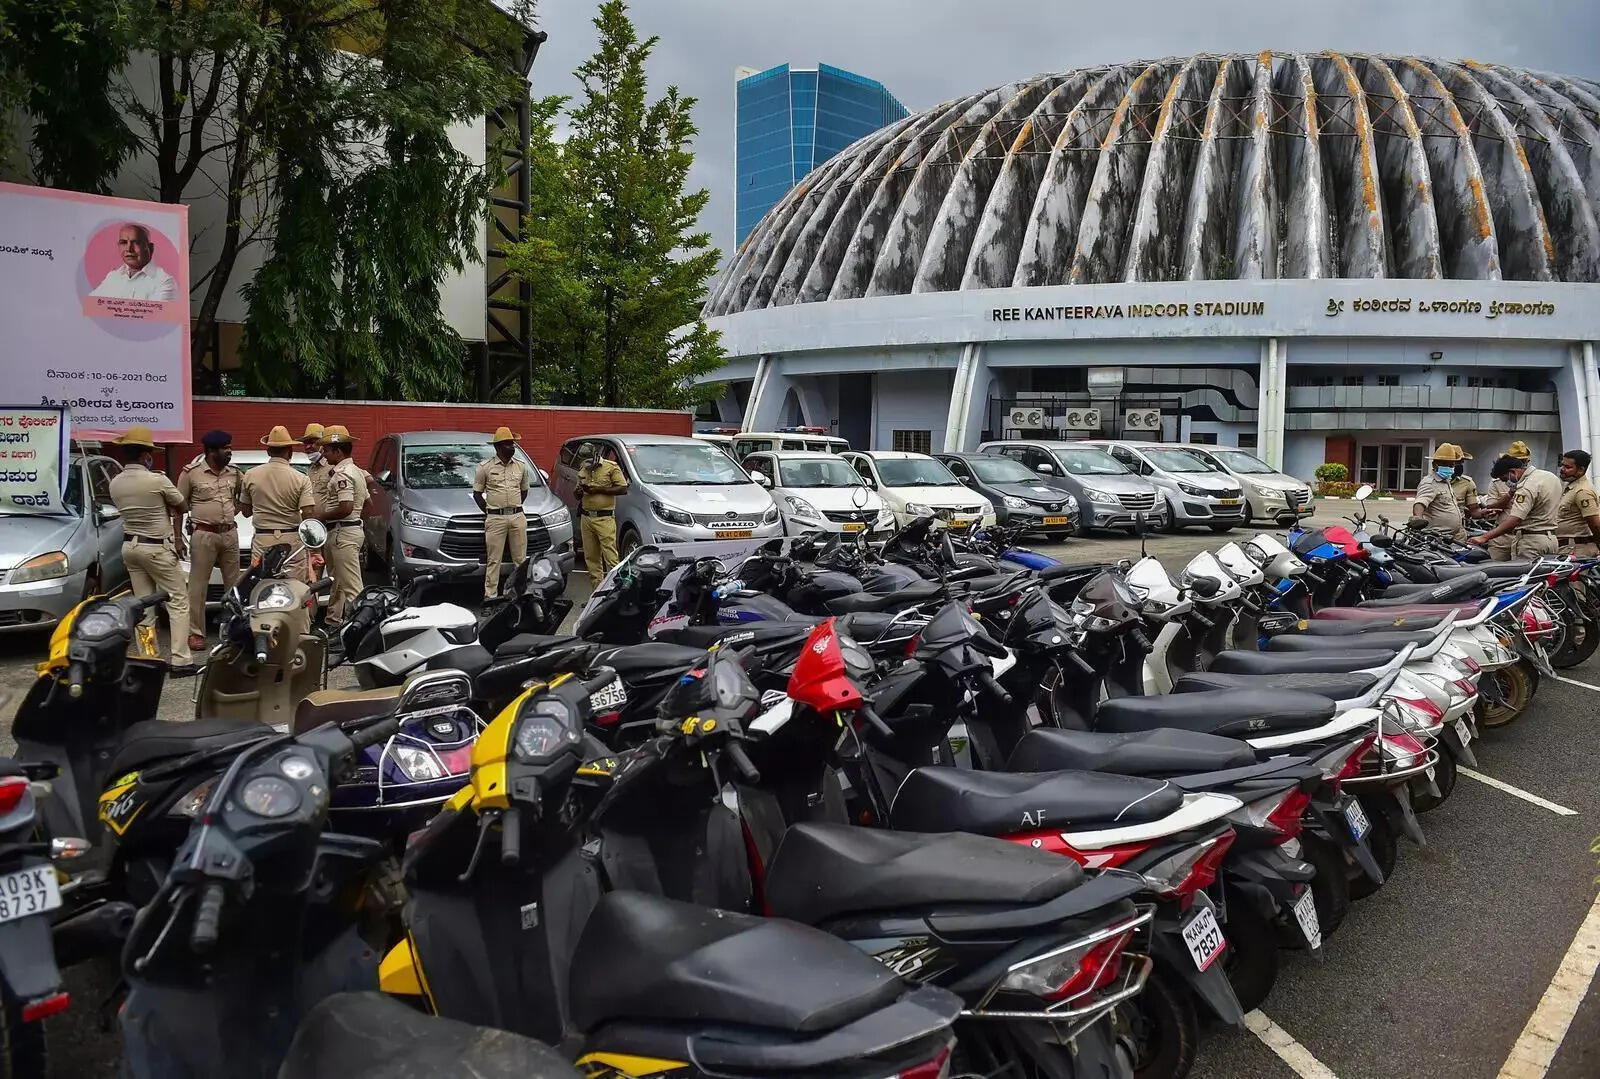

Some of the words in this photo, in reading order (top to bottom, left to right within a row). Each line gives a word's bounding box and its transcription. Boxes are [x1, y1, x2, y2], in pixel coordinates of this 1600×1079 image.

[1024, 304, 1124, 321] KANTEERAVA
[1193, 301, 1265, 317] STADIUM
[1353, 298, 1411, 312] ಕಂಠೀರವ
[1418, 298, 1482, 313] ಒಳಾಂಗಣ
[92, 372, 143, 381] 10-06-2021
[0, 889, 47, 919] 8737
[1193, 927, 1220, 963] 7837
